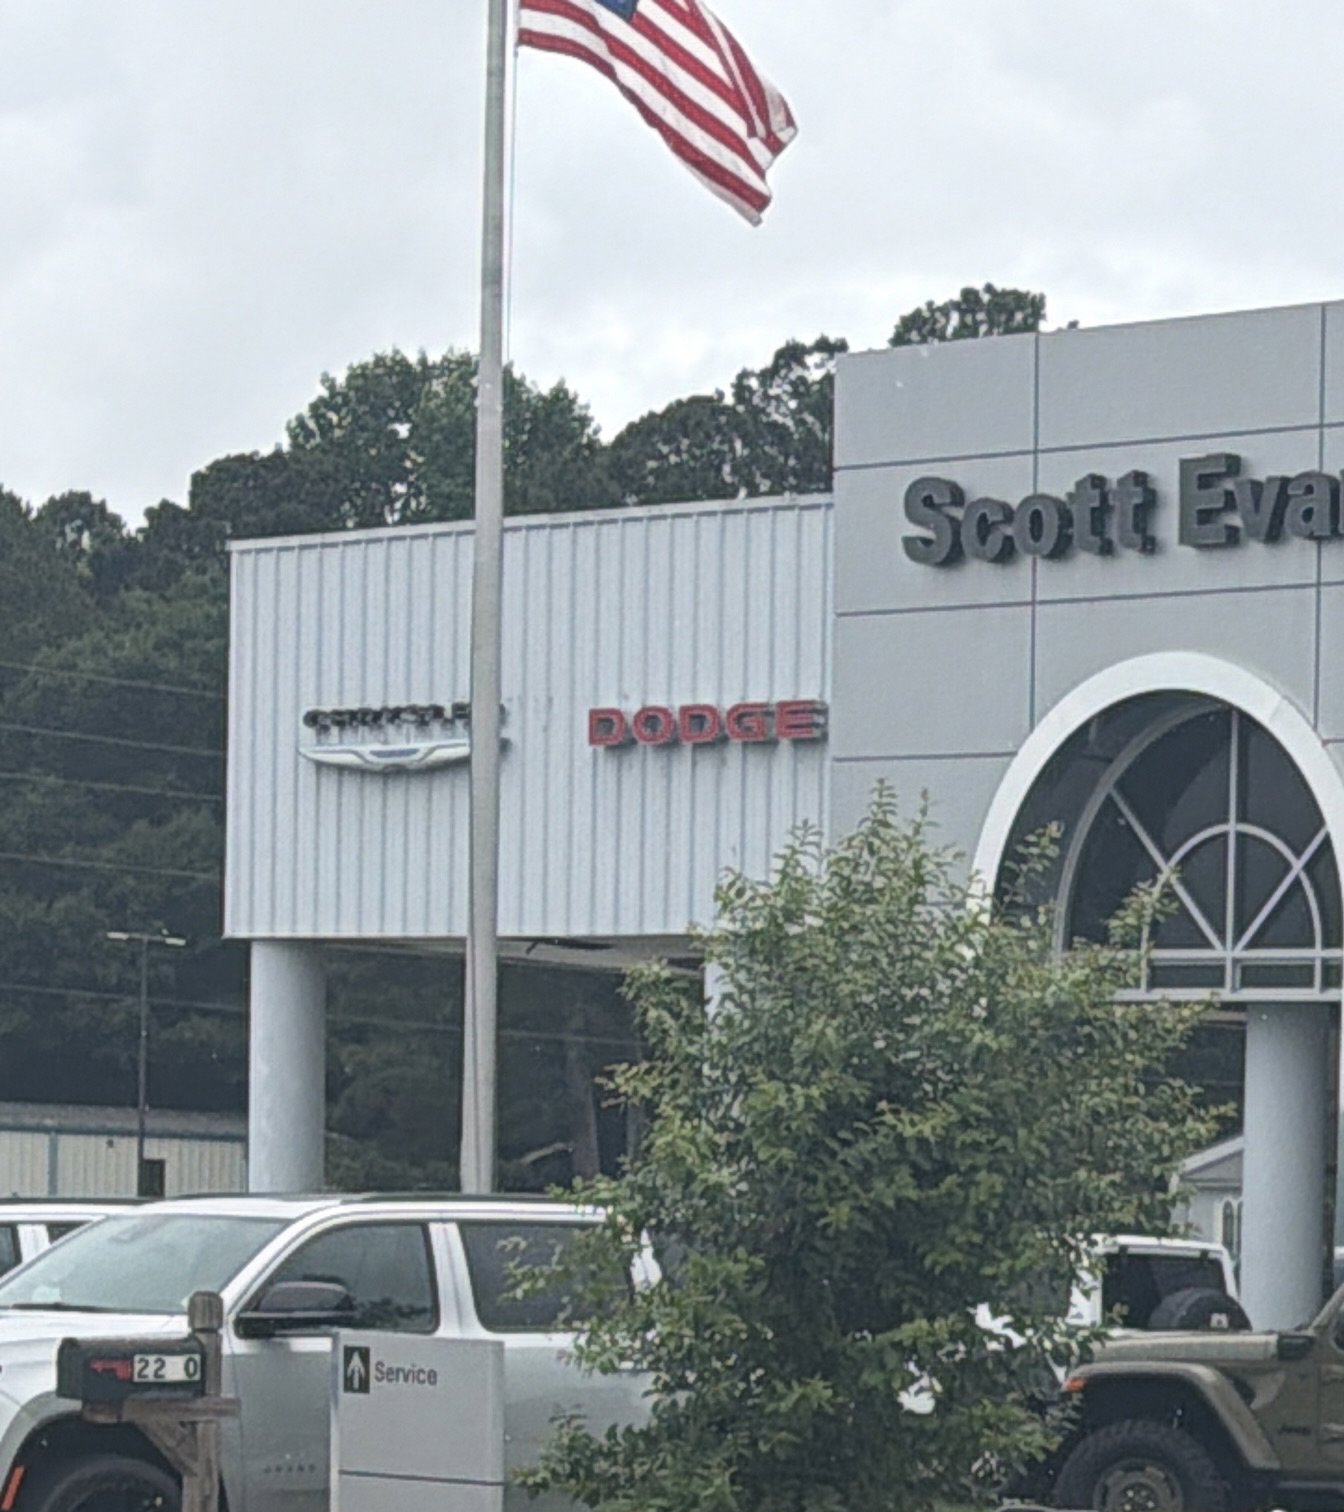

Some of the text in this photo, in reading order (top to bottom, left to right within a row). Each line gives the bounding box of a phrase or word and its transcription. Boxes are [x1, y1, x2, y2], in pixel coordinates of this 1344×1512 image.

[902, 470, 1156, 567] Scott
[588, 699, 829, 748] DODGE
[374, 1360, 438, 1386] Service
